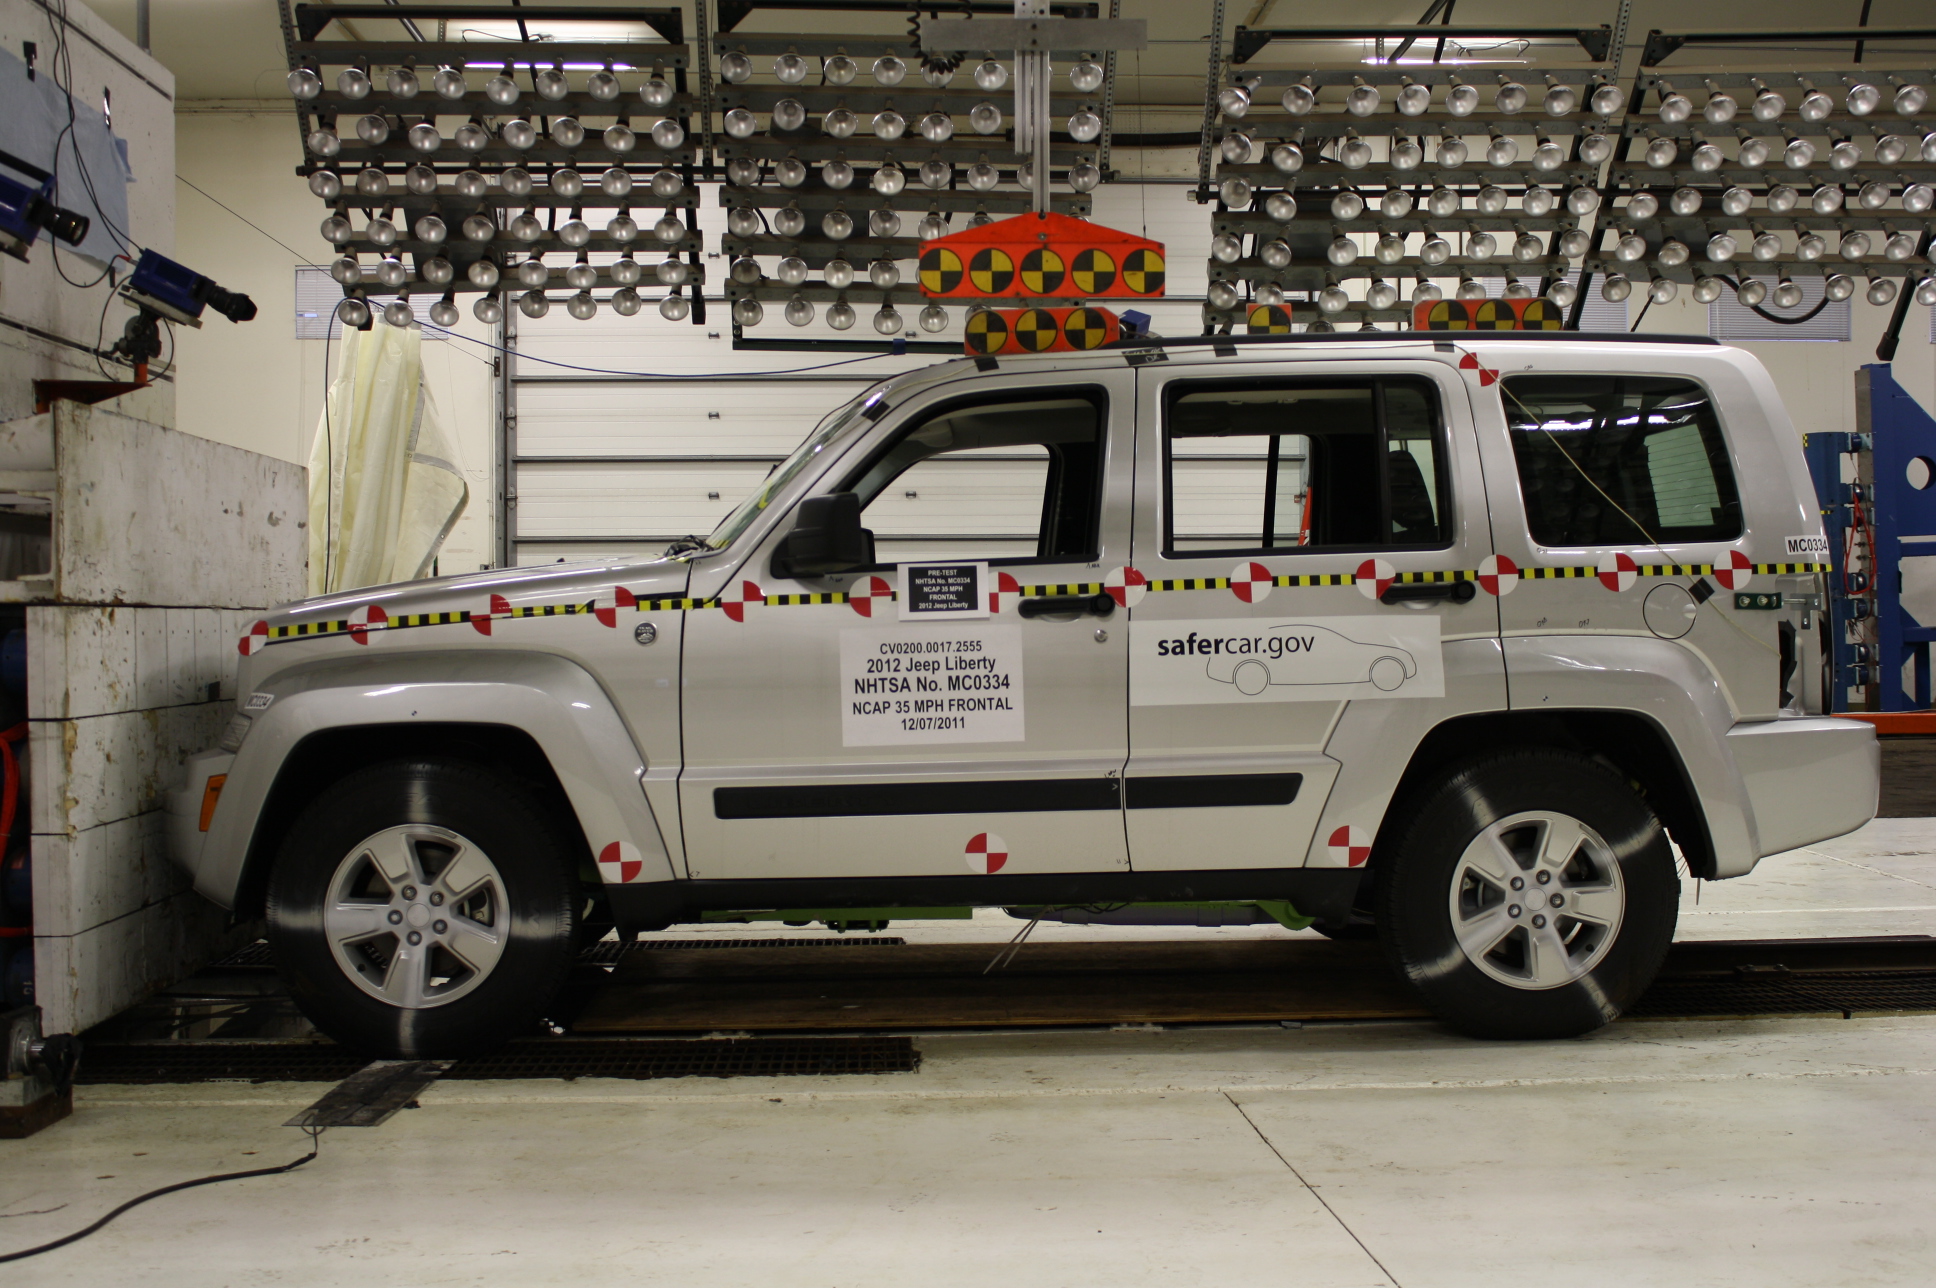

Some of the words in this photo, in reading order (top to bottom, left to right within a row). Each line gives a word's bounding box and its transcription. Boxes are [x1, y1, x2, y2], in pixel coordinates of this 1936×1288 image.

[1787, 538, 1828, 553] MC0334
[915, 577, 936, 585] NHTSA
[948, 576, 971, 584] MC0334
[923, 585, 940, 593] NCAP
[929, 593, 957, 601] FRONTAL
[933, 602, 947, 610] Jeep
[948, 601, 969, 610] Liberty
[880, 640, 983, 655] CV0200.0017.2555
[1157, 632, 1315, 659] safercar.gov
[866, 658, 901, 673] 2012
[905, 657, 940, 675] Jeep
[945, 656, 996, 673] Liberty
[854, 677, 911, 694] NHTSA
[916, 676, 943, 692] No.
[947, 673, 1010, 691] MC0334
[852, 701, 891, 715] NCAP
[895, 700, 910, 714] 35
[914, 699, 944, 713] MPH
[948, 697, 1013, 712] FRONTAL
[901, 716, 965, 731] 12/07/2011
